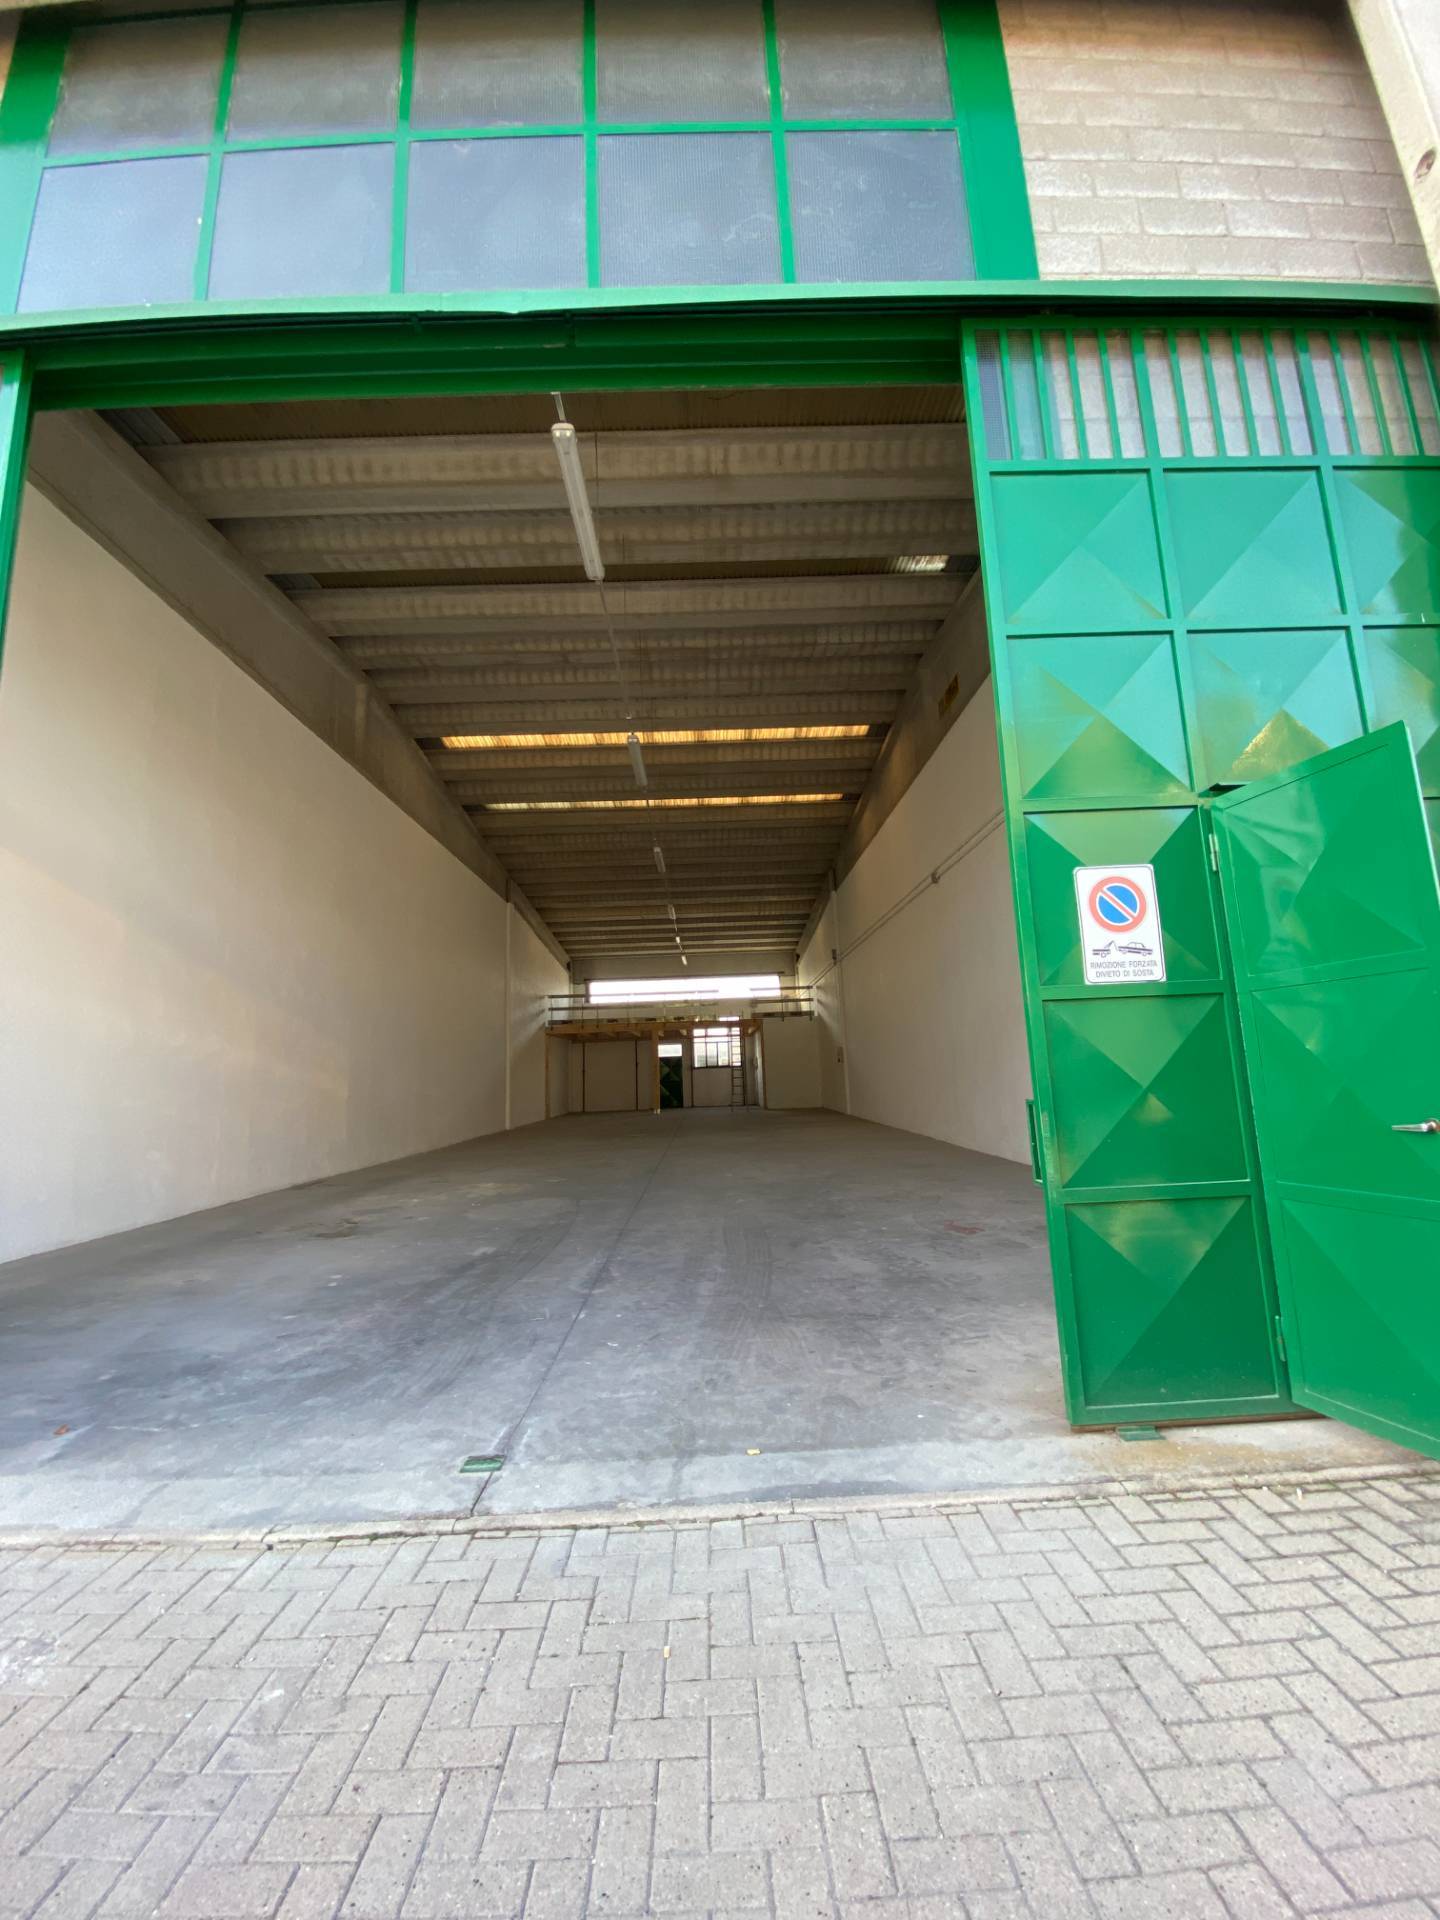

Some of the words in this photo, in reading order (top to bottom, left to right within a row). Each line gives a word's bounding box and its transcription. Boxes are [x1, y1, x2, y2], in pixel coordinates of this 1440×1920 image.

[1090, 961, 1127, 969] RIMOZIONE
[1129, 960, 1158, 968] FORZATA
[1095, 970, 1121, 978] DIVIETO
[1132, 969, 1155, 977] SOSTA
